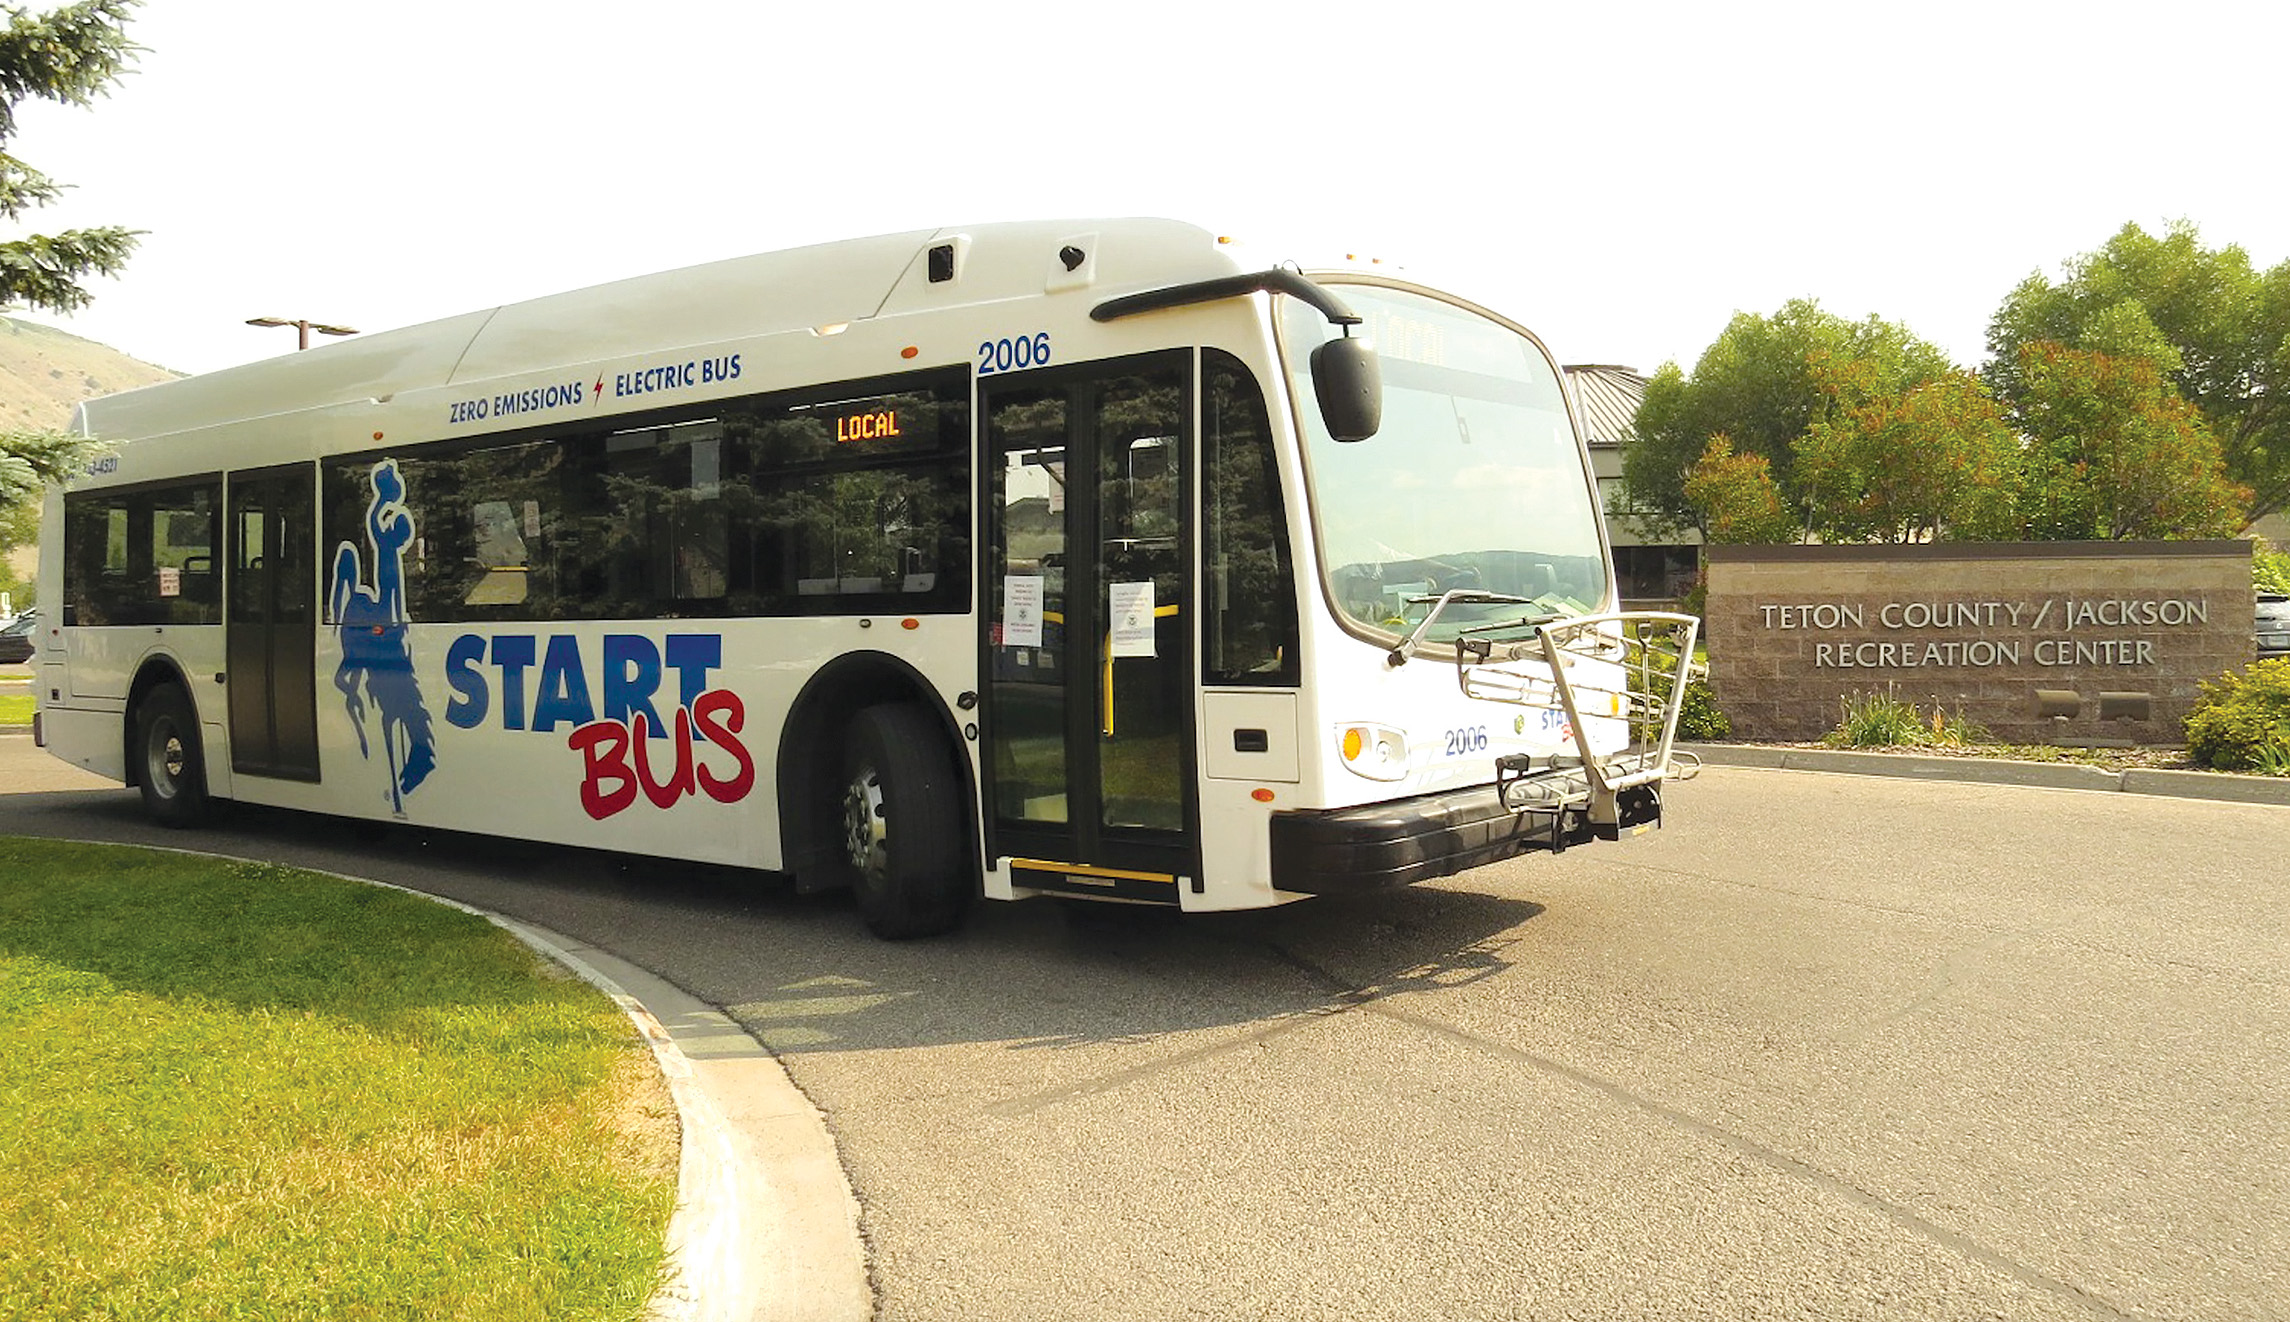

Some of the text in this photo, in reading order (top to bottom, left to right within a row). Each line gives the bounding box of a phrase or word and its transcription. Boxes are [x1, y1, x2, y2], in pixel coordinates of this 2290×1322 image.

[977, 332, 1051, 374] 2006
[449, 354, 741, 423] ZERO EMISSIONS ELECTRIC BUS
[837, 411, 899, 442] LOCAL
[1759, 603, 1864, 630] TETON
[1880, 602, 2025, 629] COUNTY
[2065, 600, 2209, 632] JACKSON
[1814, 640, 2155, 668] RECREATION CENTER
[445, 634, 722, 741] START
[568, 689, 755, 820] BUS
[1444, 725, 1488, 756] 2006
